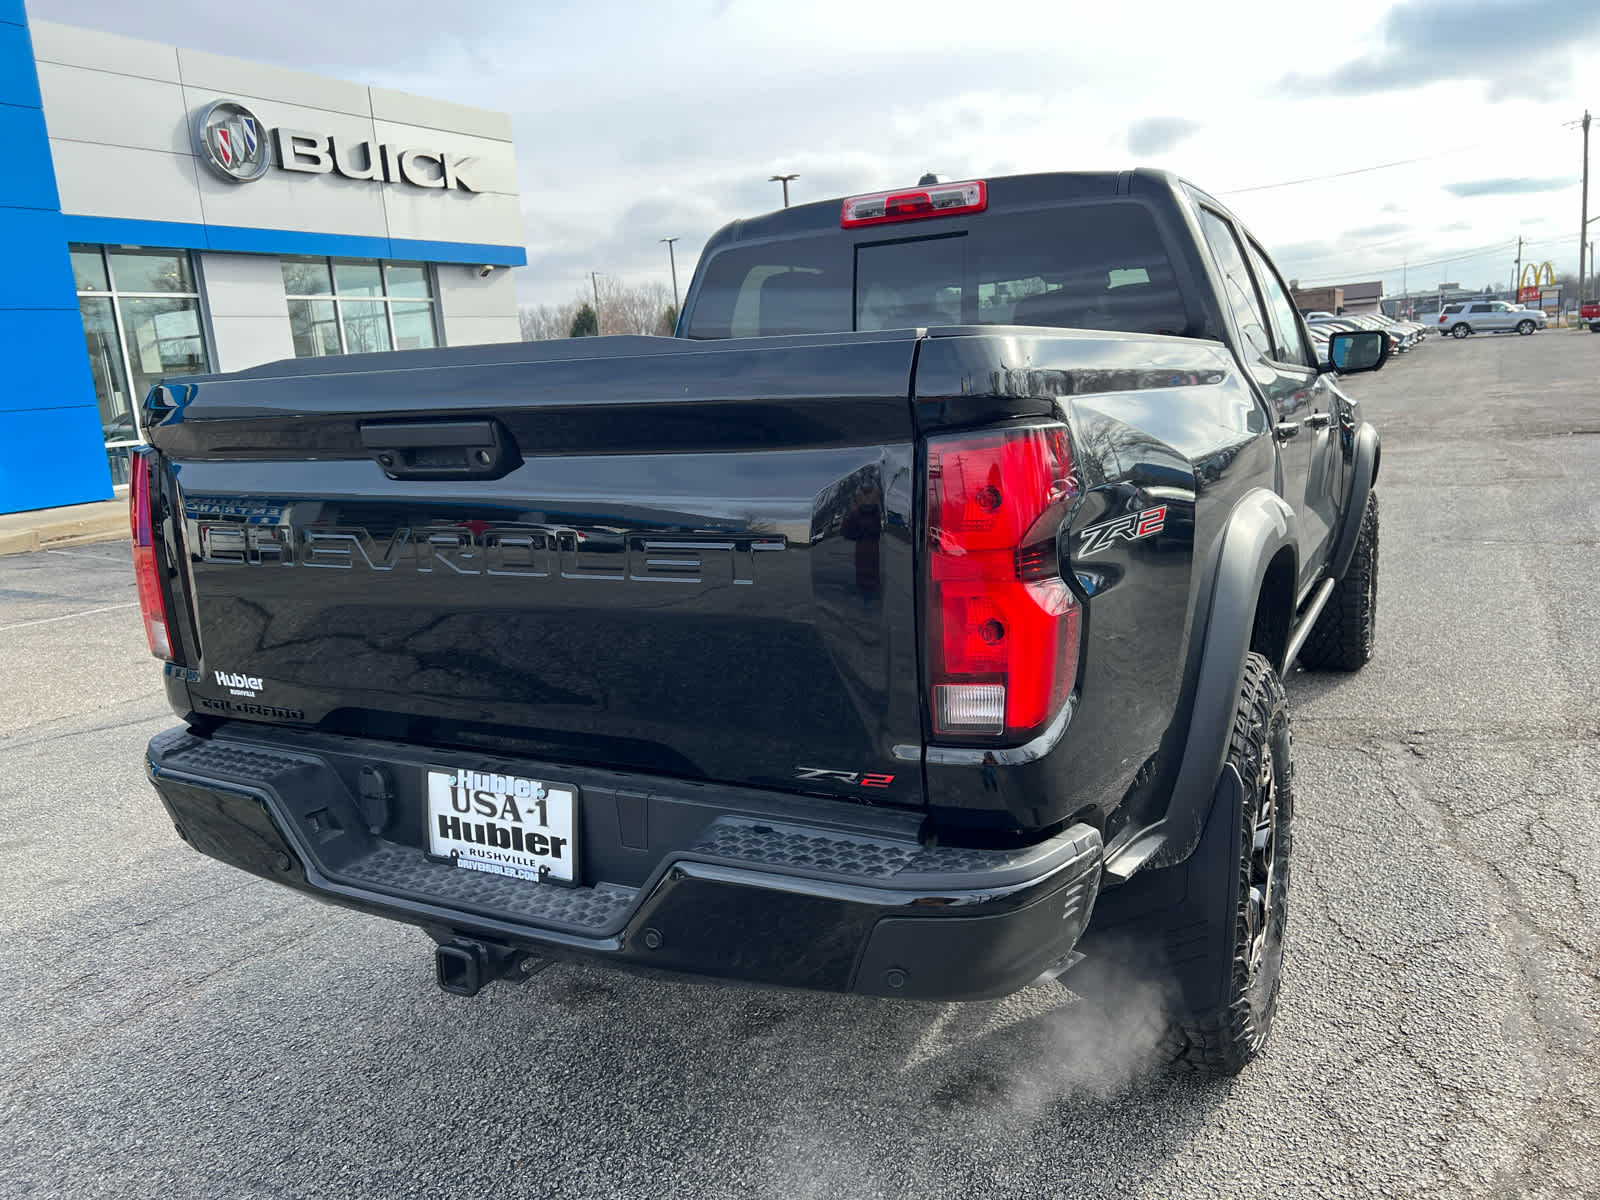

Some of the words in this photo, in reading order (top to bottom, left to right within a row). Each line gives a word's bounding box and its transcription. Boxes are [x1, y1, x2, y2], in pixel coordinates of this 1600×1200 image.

[271, 127, 480, 193] BUICK
[1078, 504, 1168, 560] ZR2
[199, 521, 788, 585] CHEVROLET
[214, 670, 264, 691] Hubler
[457, 769, 542, 799] Hubler
[793, 767, 896, 789] ZR2
[450, 786, 550, 828] USA-1
[438, 814, 568, 860] Hubler
[457, 859, 539, 883] DRIVEHUBLER.COM
[469, 848, 536, 868] RUSHVILLE
